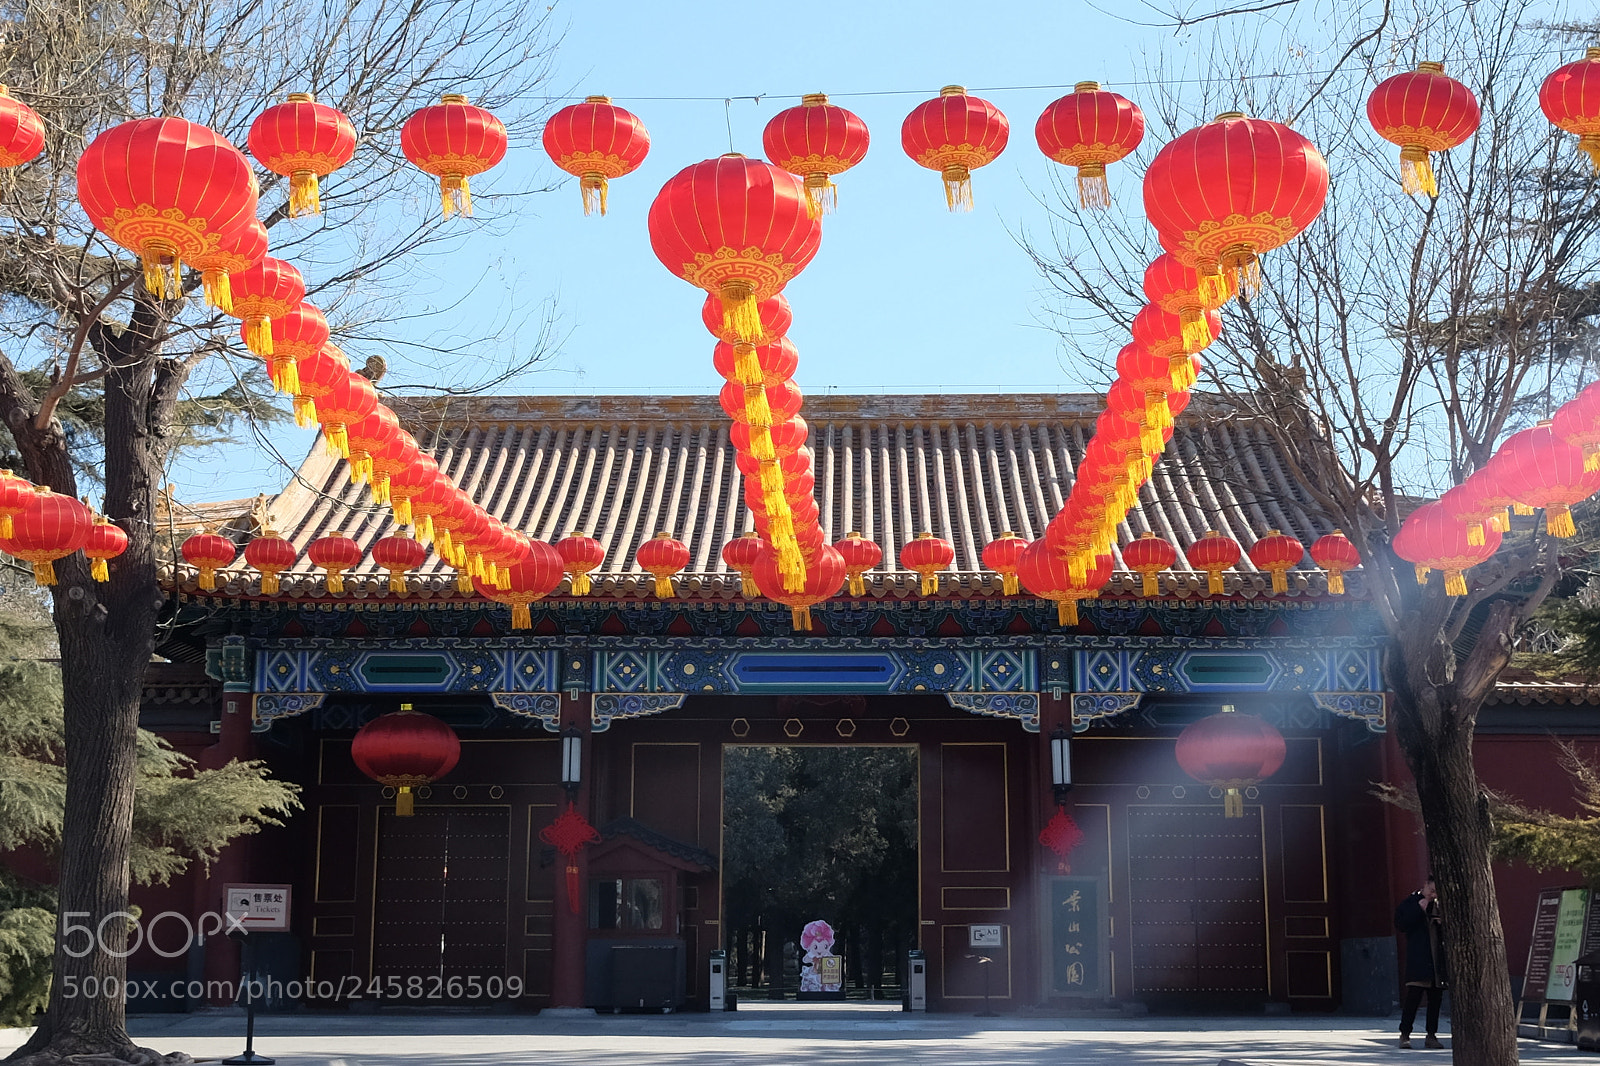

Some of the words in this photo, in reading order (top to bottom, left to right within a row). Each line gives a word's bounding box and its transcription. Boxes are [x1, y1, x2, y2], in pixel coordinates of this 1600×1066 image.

[253, 893, 283, 903] 售票处
[255, 905, 281, 913] Tickets
